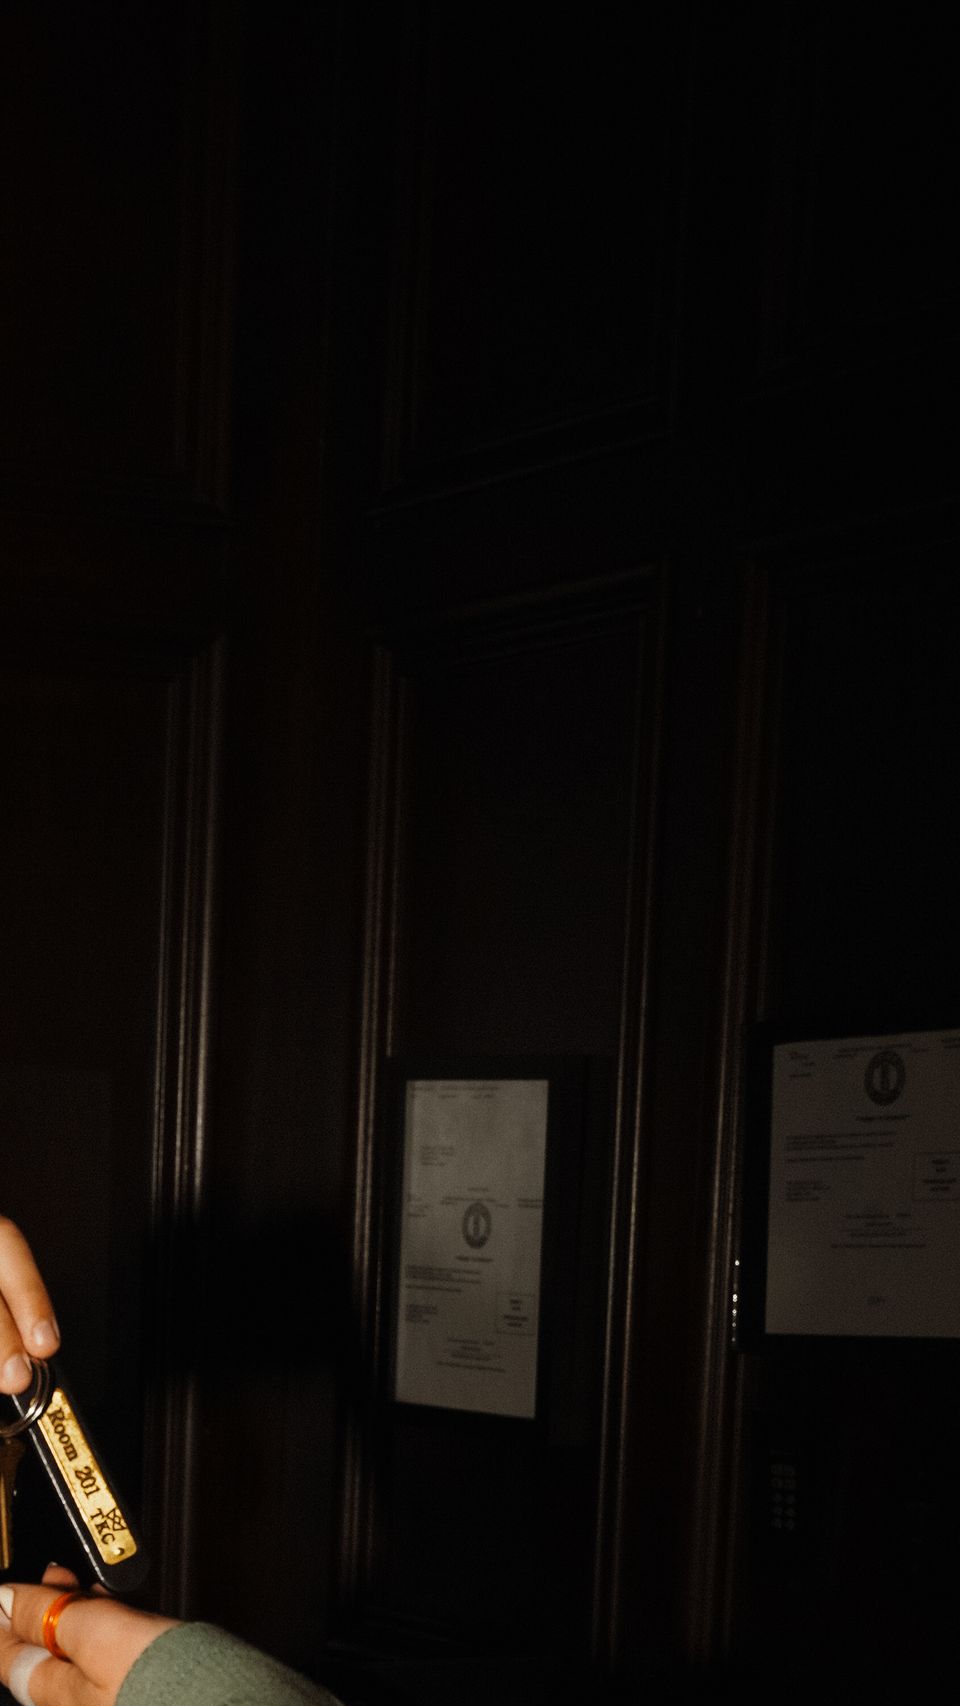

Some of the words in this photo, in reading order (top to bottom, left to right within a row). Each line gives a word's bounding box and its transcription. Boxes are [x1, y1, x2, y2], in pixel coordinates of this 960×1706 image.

[46, 1407, 78, 1462] Room
[75, 1466, 102, 1500] 201
[90, 1507, 116, 1546] TKC
